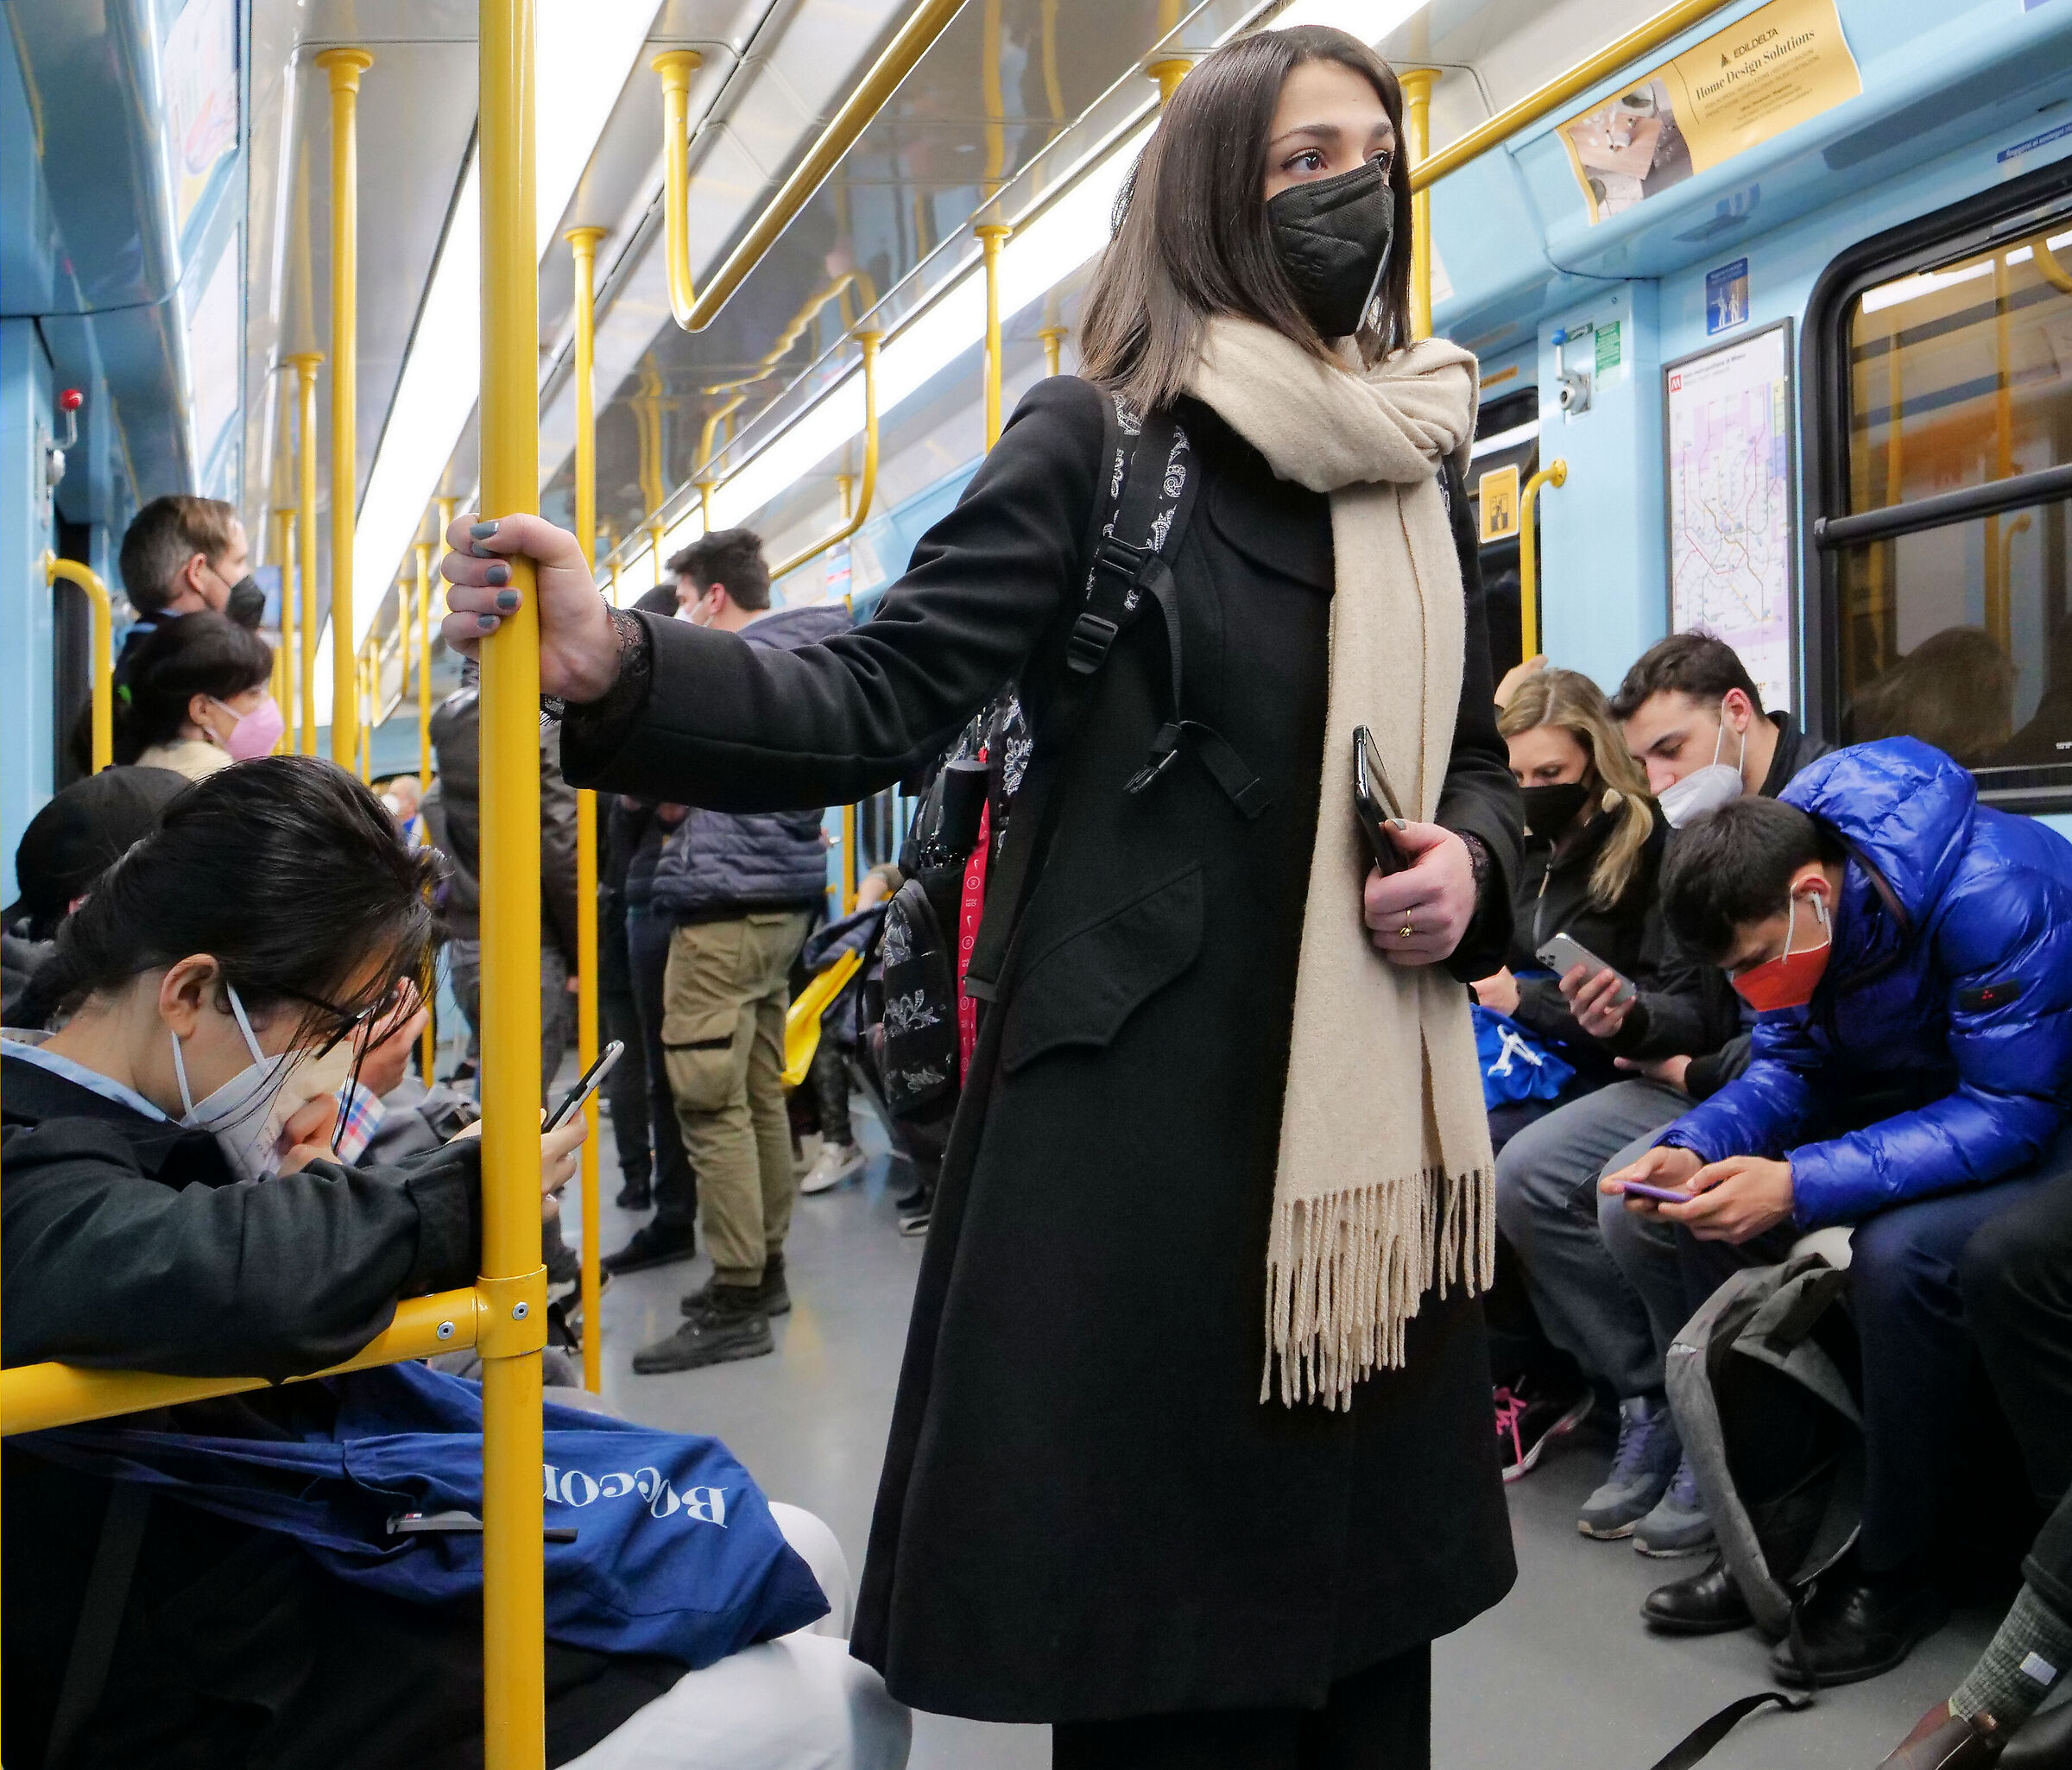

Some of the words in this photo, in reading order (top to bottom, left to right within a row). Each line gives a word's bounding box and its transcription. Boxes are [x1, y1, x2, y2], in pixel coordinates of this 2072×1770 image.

[1696, 78, 1725, 100] Home
[1726, 58, 1763, 84] Design
[1763, 30, 1815, 64] Solutions
[1733, 28, 1779, 58] EDILDELTA
